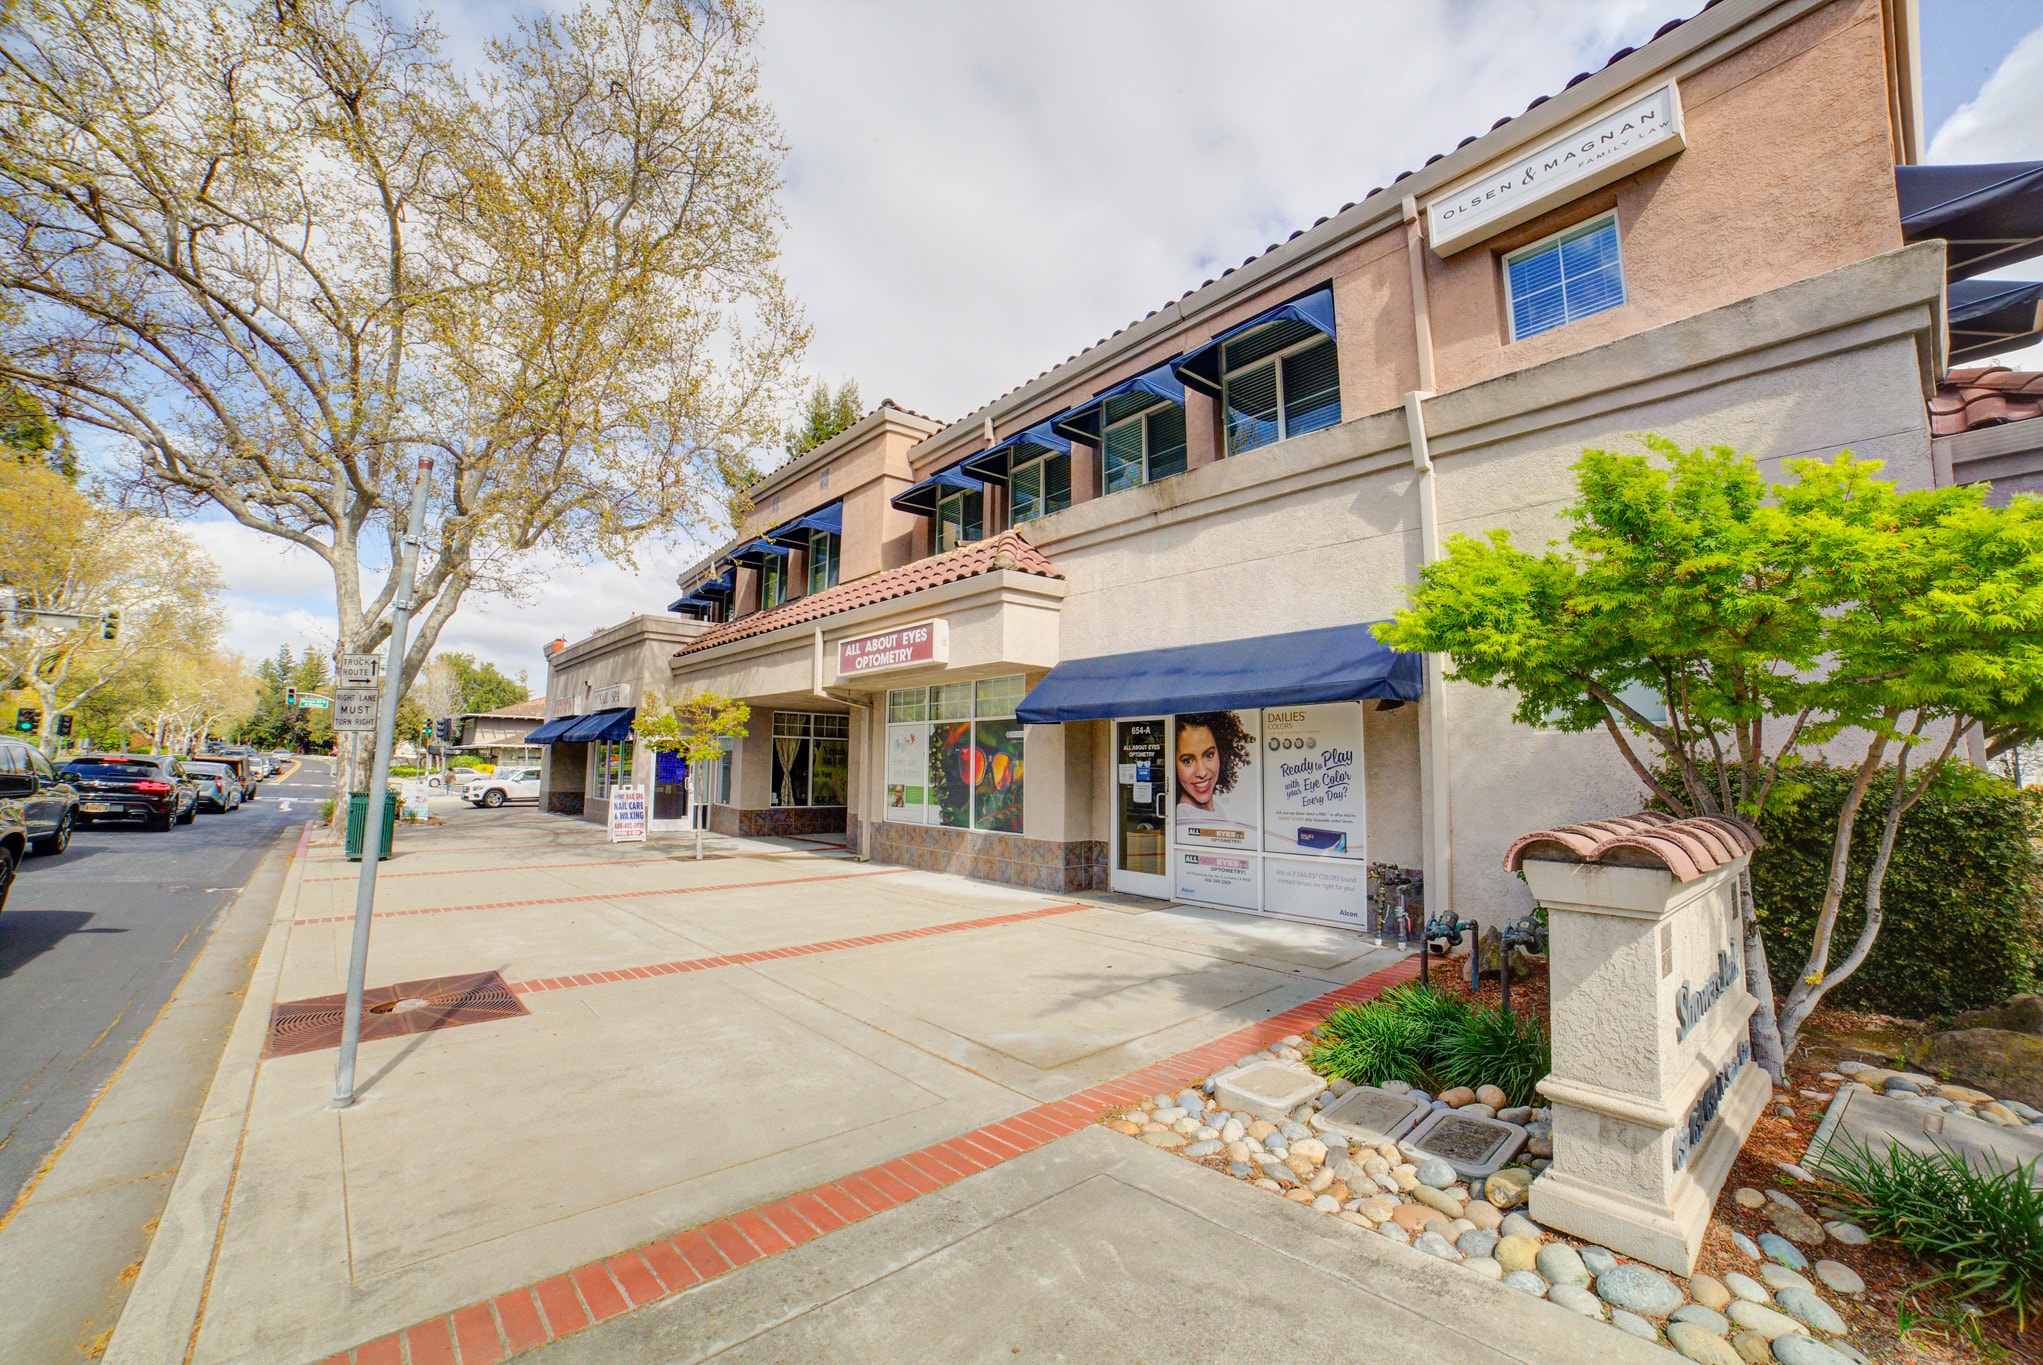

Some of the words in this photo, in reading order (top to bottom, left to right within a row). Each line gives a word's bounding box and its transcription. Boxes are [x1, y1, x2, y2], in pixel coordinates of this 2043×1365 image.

[1578, 139, 1630, 168] FAMILY
[1639, 119, 1670, 139] LAW
[1443, 181, 1512, 220] OLSEN
[1521, 166, 1536, 186] &
[1543, 110, 1655, 172] MAGNAN
[845, 644, 861, 656] ALL
[865, 634, 897, 653] ABOUT
[902, 628, 927, 645] EYES
[855, 647, 913, 669] OPTOMETRY
[337, 694, 356, 702] RIGHT
[359, 694, 377, 702] LANE
[340, 706, 370, 714] MUST
[1131, 726, 1151, 735] 654-A
[1280, 757, 1313, 777] Ready
[1315, 763, 1323, 771] to
[1321, 748, 1353, 768] Play
[1285, 779, 1300, 790] with
[1304, 778, 1320, 793] Eye
[1322, 770, 1351, 786] Color
[1287, 788, 1302, 800] your
[1302, 796, 1324, 807] Every
[1326, 786, 1348, 802] Day?
[614, 802, 627, 810] NAIL
[628, 802, 644, 810] CARE
[620, 812, 644, 820] WAXING
[1188, 828, 1200, 836] ALL
[1185, 855, 1199, 864] ALL
[1216, 859, 1238, 867] EYES
[1319, 873, 1339, 881] COLORS
[1340, 909, 1358, 918] Alcon
